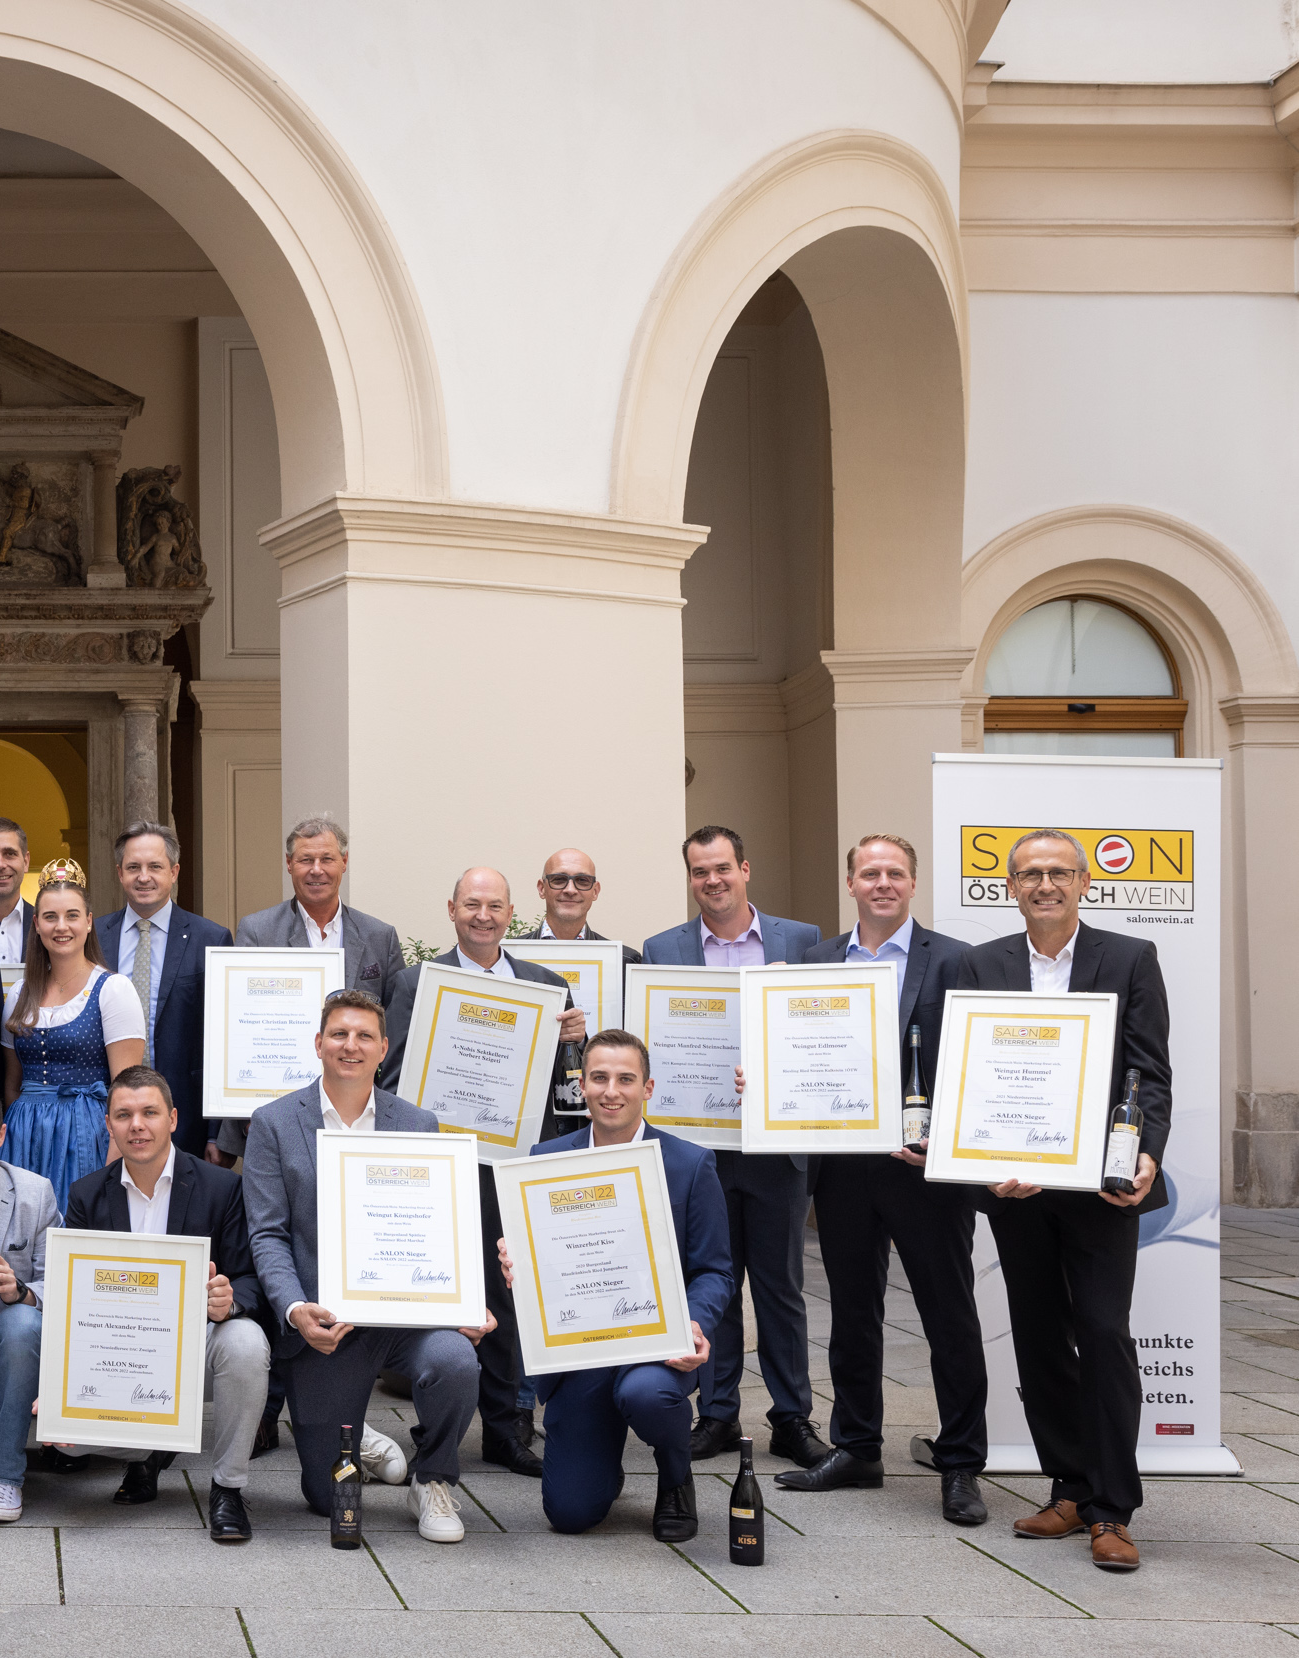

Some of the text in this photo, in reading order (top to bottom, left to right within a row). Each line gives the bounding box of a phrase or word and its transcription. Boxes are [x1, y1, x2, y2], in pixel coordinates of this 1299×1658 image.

[971, 833, 1182, 875] SON
[1124, 887, 1185, 905] WEIN
[1126, 915, 1194, 924] salonwein.at
[249, 979, 300, 988] SALON 22
[565, 973, 578, 982] 22
[670, 1000, 724, 1010] SALON 22
[790, 998, 847, 1009] SALON 22
[461, 1004, 515, 1024] SALON 22
[459, 1015, 496, 1028] ÖSTERREICH
[994, 1028, 1058, 1038] SALON 22
[458, 1051, 481, 1060] Norbert
[454, 1089, 496, 1103] SALON Sieger
[368, 1167, 426, 1178] SALON 22
[551, 1187, 613, 1204] SALON 22
[553, 1201, 596, 1213] ÖSTERREICH
[96, 1271, 156, 1285] SALON 22
[576, 1278, 624, 1290] SALON Sieger
[95, 1284, 137, 1293] ÖSTERREICH
[78, 1321, 171, 1334] Weingut Alexander Egermann
